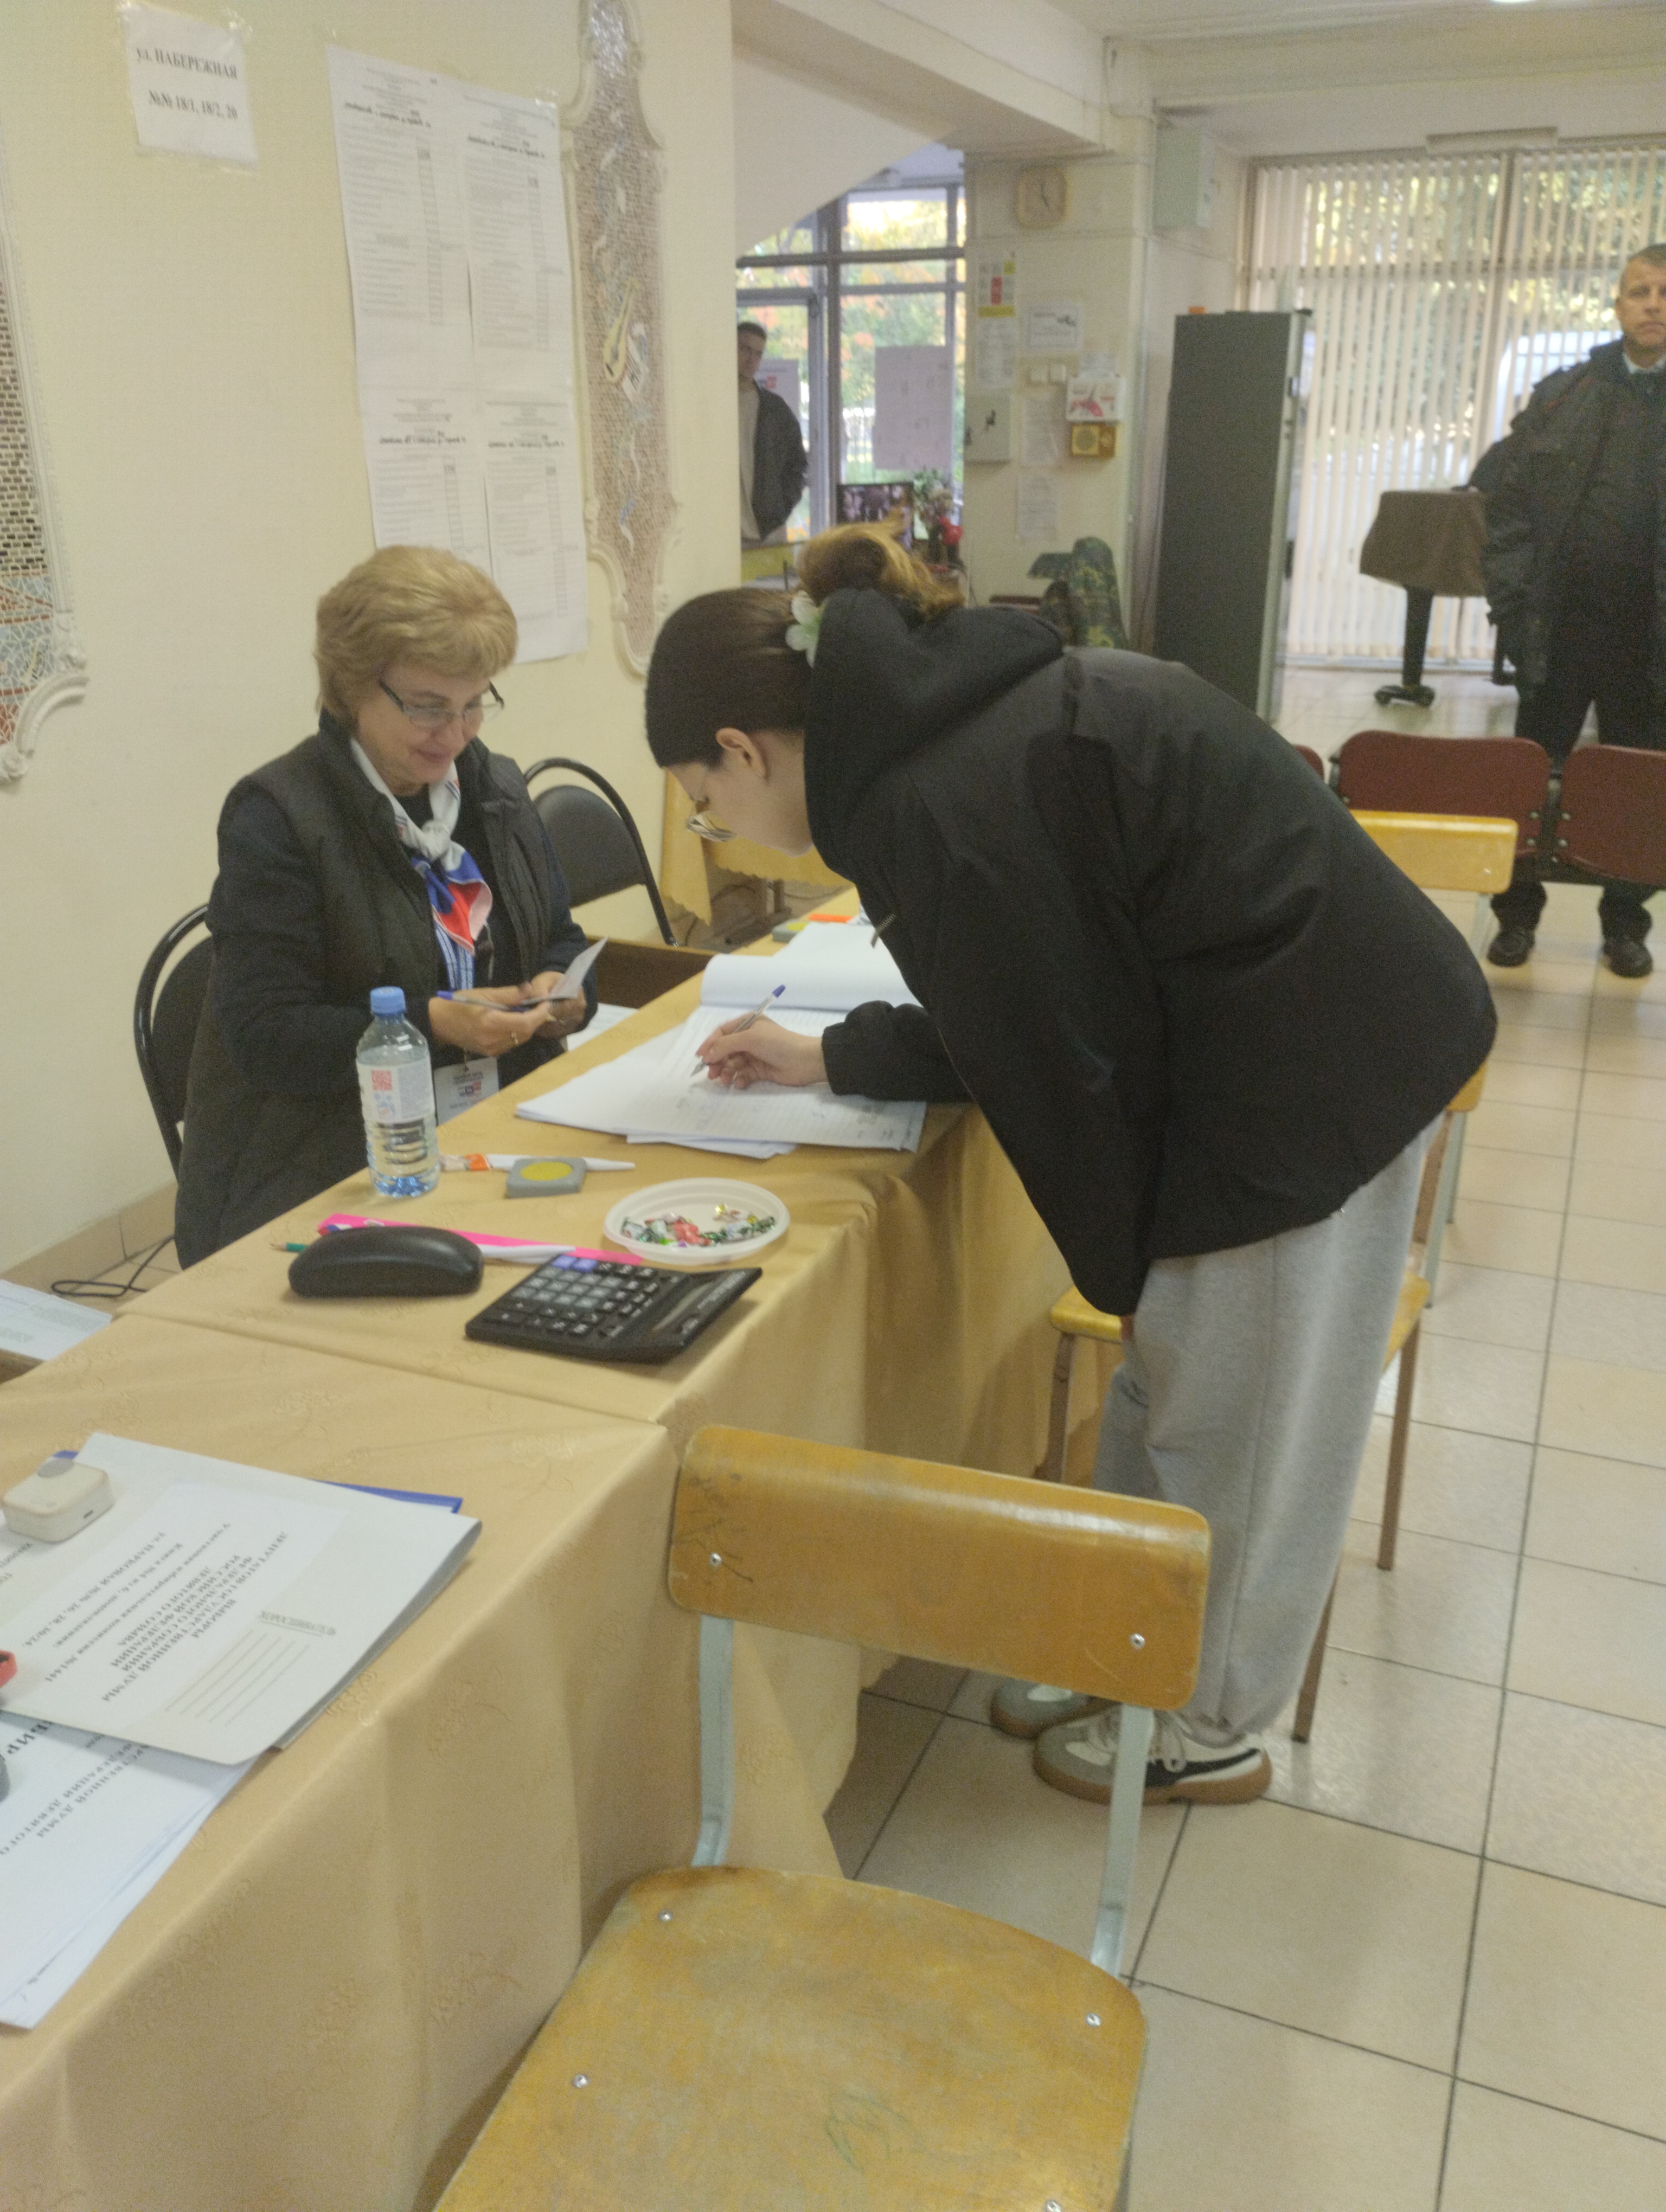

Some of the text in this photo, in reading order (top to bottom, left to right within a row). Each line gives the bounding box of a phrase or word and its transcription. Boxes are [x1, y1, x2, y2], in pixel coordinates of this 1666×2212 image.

[155, 48, 237, 79] НАБЕРЕЖНАЯ
[102, 1532, 287, 1701] ДЕПУТАТОВ ГОСУДАРСТВЕННОЙ ДУМЫ
[111, 1555, 240, 1667] РОССИЙСКОЙ ФЕДЕРАЦИИ
[117, 1566, 212, 1645] ДЕВЯТОГО СОЗЫВА
[122, 1557, 252, 1671] ФЕДЕРАЛЬНОГО СОБРАНИЯ
[191, 1599, 236, 1638] ВЫБОРЫ
[37, 1804, 73, 1837] ДУМЫ
